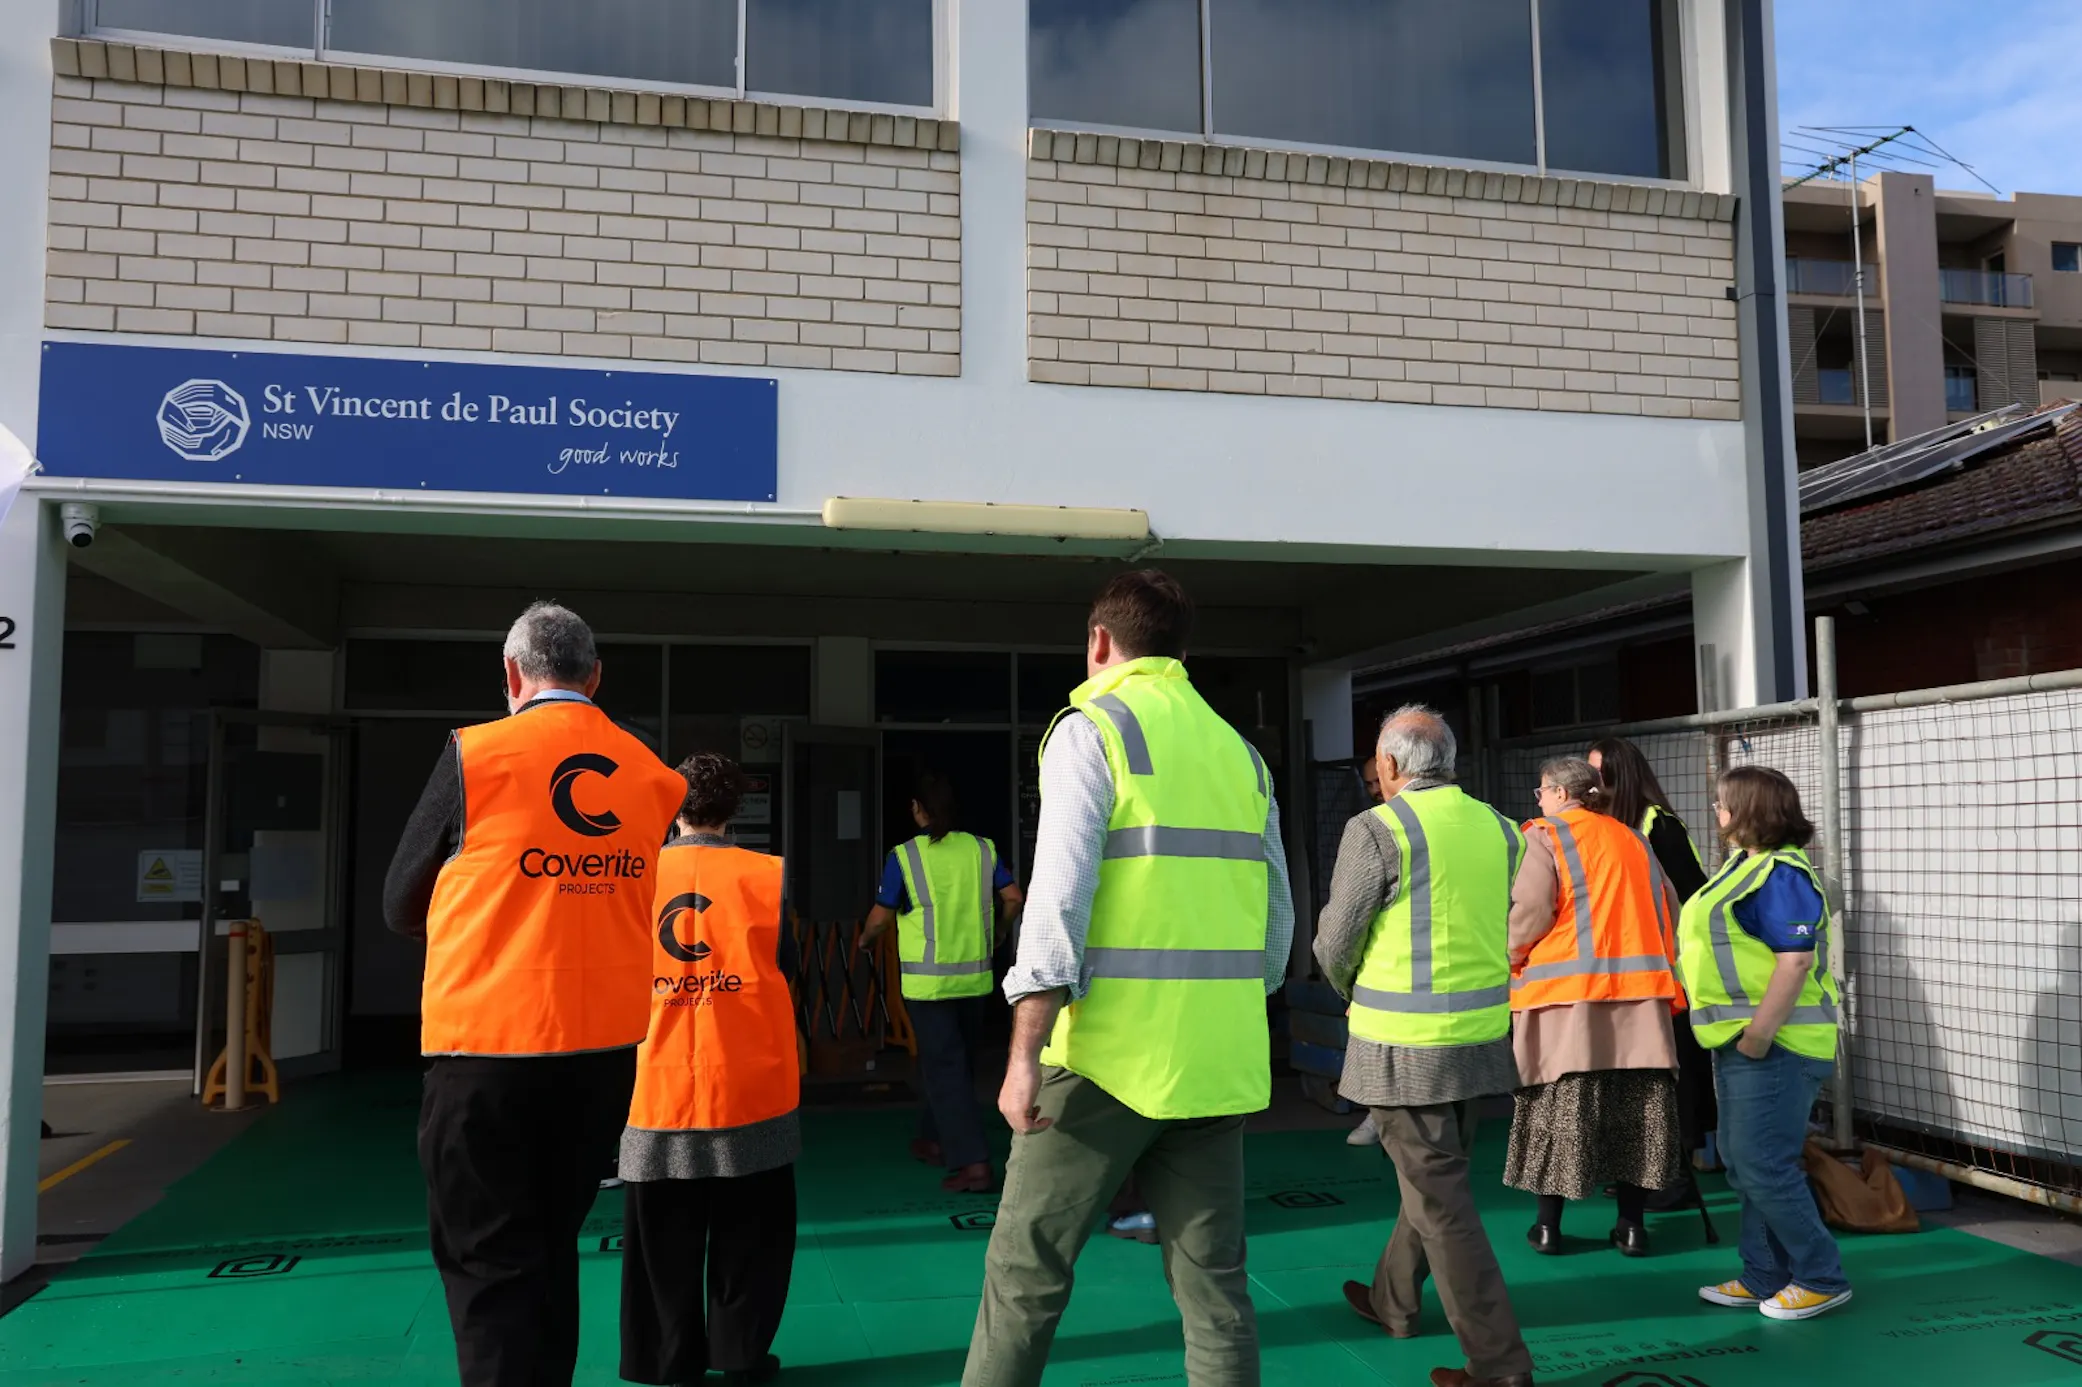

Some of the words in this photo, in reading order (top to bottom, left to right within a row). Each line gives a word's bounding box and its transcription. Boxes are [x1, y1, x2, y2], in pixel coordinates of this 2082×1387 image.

[263, 384, 297, 415] St
[305, 386, 432, 419] Vincent
[441, 392, 479, 422] de
[488, 395, 558, 426] Paul
[569, 399, 680, 438] Society
[262, 422, 314, 440] NSW
[547, 442, 611, 474] good
[619, 438, 680, 468] works
[519, 847, 645, 879] Coverite
[559, 883, 615, 894] PROJECTS
[653, 970, 742, 993] overite
[664, 997, 713, 1007] PROJECTS
